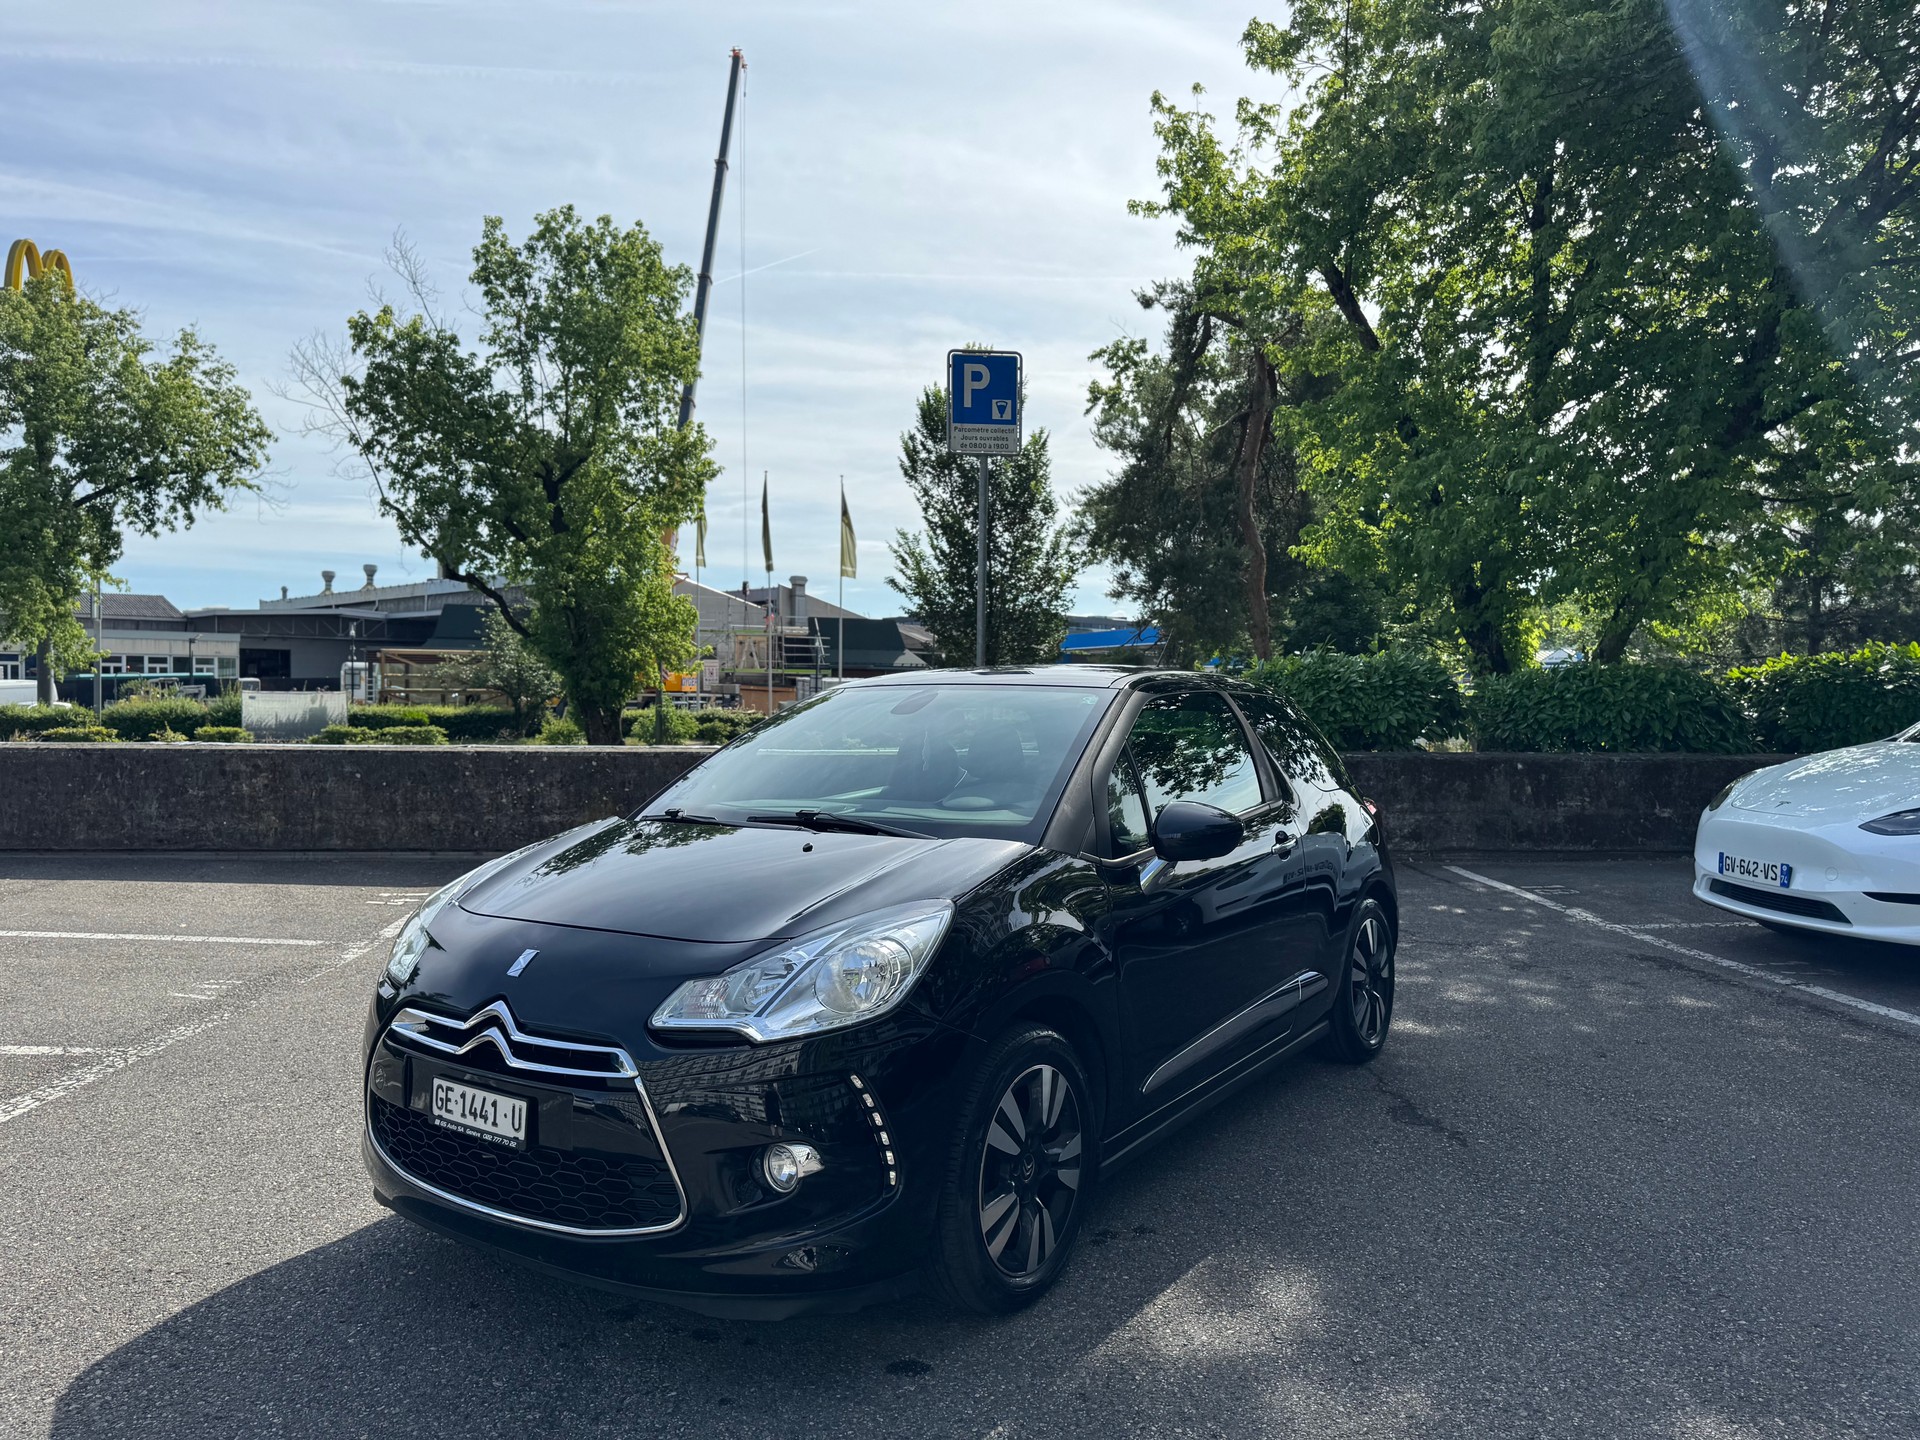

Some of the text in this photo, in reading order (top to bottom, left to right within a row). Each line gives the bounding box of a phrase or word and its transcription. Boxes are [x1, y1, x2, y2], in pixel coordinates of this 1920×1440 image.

[963, 363, 990, 408] P
[953, 426, 989, 434] Parcomètre
[1724, 855, 1778, 881] GV-642-VS
[492, 1135, 502, 1143] 777
[502, 1138, 510, 1146] 70
